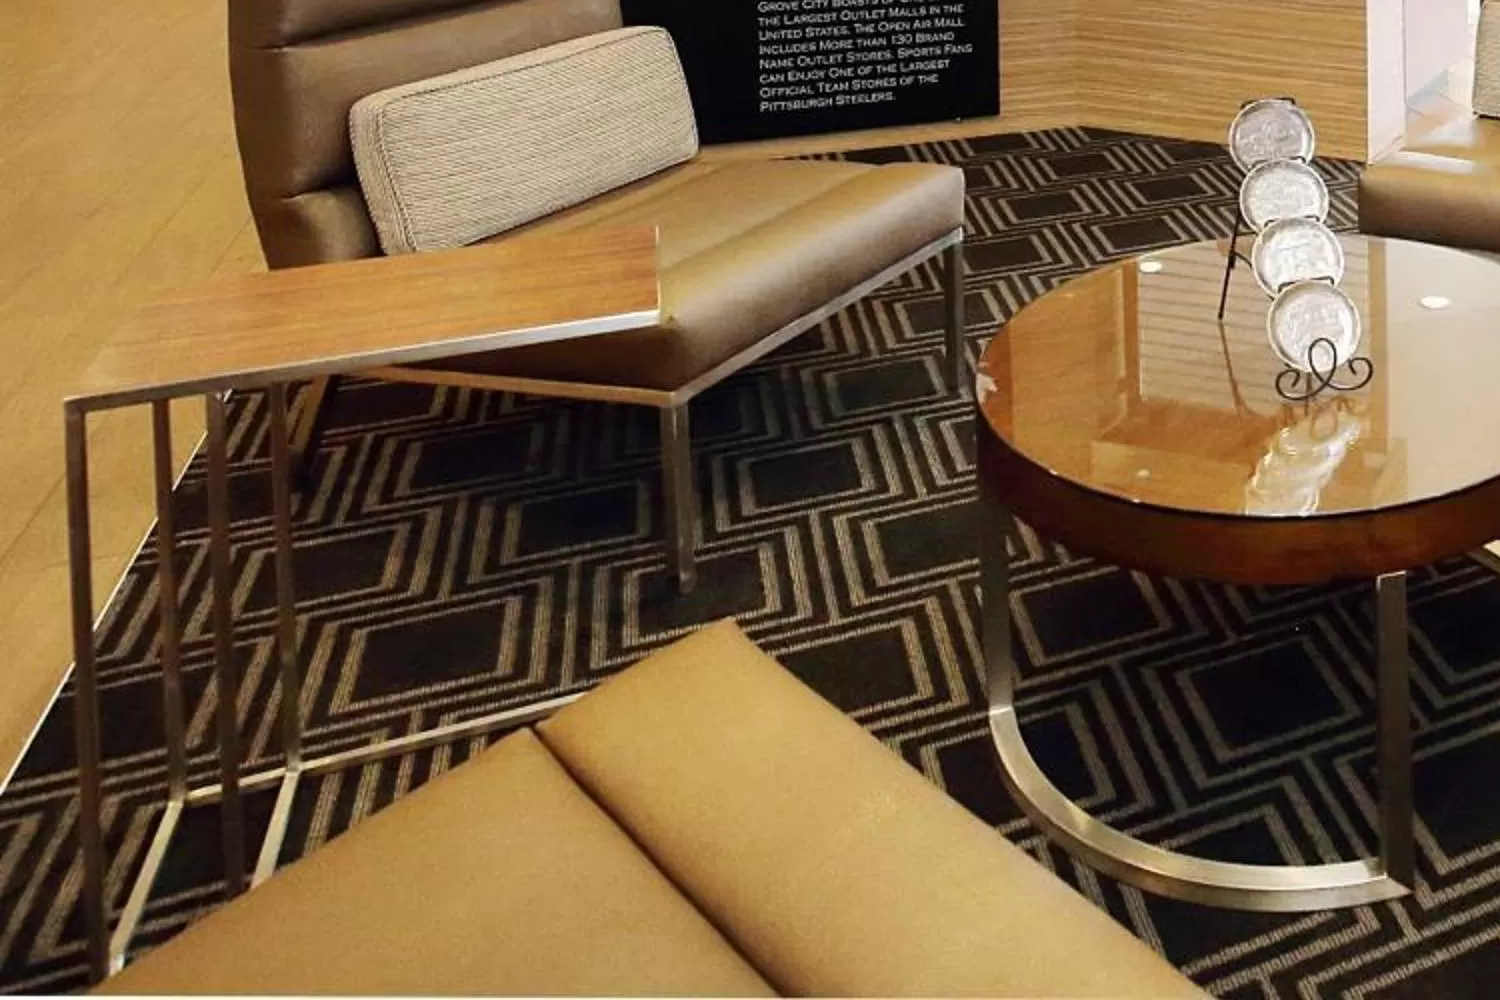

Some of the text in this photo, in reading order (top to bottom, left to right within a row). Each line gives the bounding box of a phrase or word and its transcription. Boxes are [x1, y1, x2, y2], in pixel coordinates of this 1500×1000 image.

[757, 0, 800, 13] GROVE
[757, 3, 965, 27] THE LARGEST OUTLET MALLS IN THE
[758, 28, 804, 41] UNITED
[853, 22, 876, 34] THE
[877, 20, 911, 32] OPEN
[912, 18, 933, 29] AIR
[759, 41, 818, 56] INCLUDES
[819, 38, 856, 51] MORE
[856, 37, 887, 48] THAN
[915, 30, 955, 43] BRAND
[759, 56, 795, 70] NAME
[797, 51, 845, 67] OUTLET
[897, 46, 943, 59] SPORTS
[943, 42, 974, 55] FANS
[759, 58, 951, 85] CAN ENJOY ONE OF THE LARGEST
[759, 73, 940, 99] OFFICIAL TEAM STORES OF THE
[759, 98, 834, 113] PITTSBURGH
